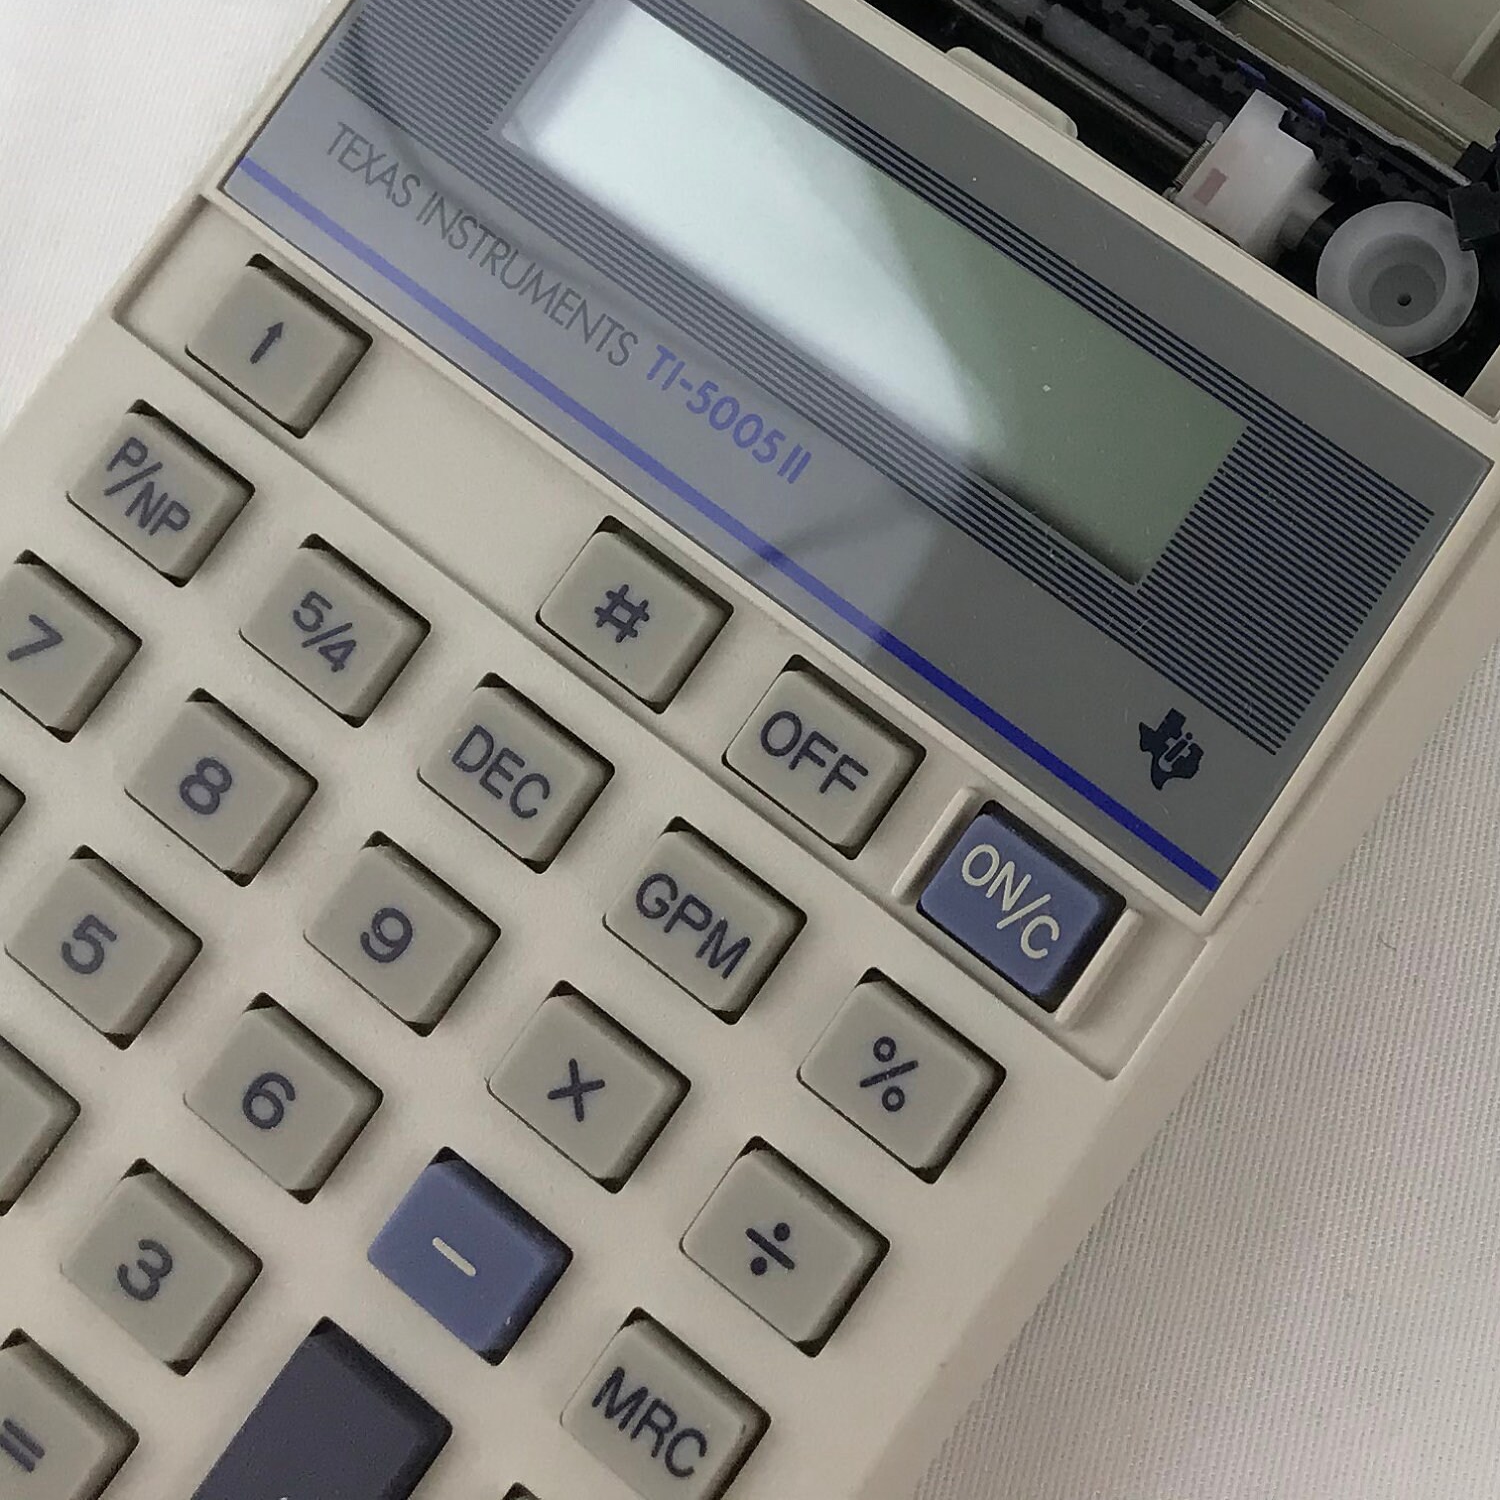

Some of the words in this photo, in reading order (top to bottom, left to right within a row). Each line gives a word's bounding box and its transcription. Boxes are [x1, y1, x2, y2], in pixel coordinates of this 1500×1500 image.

[326, 123, 420, 208] TEXAS
[415, 190, 639, 367] INSTRUMENTS
[104, 437, 191, 537] P/NP
[7, 613, 64, 663] 7
[291, 590, 359, 674] 5/4
[179, 756, 234, 816] 8
[450, 724, 551, 820] DEC
[759, 710, 869, 796] OFF
[60, 913, 117, 975] 5
[359, 907, 414, 964] 9
[634, 873, 752, 980] GPM
[960, 843, 1060, 960] ON/C
[241, 1071, 297, 1130] 6
[117, 1238, 174, 1301] 3
[592, 1366, 708, 1479] MRC
